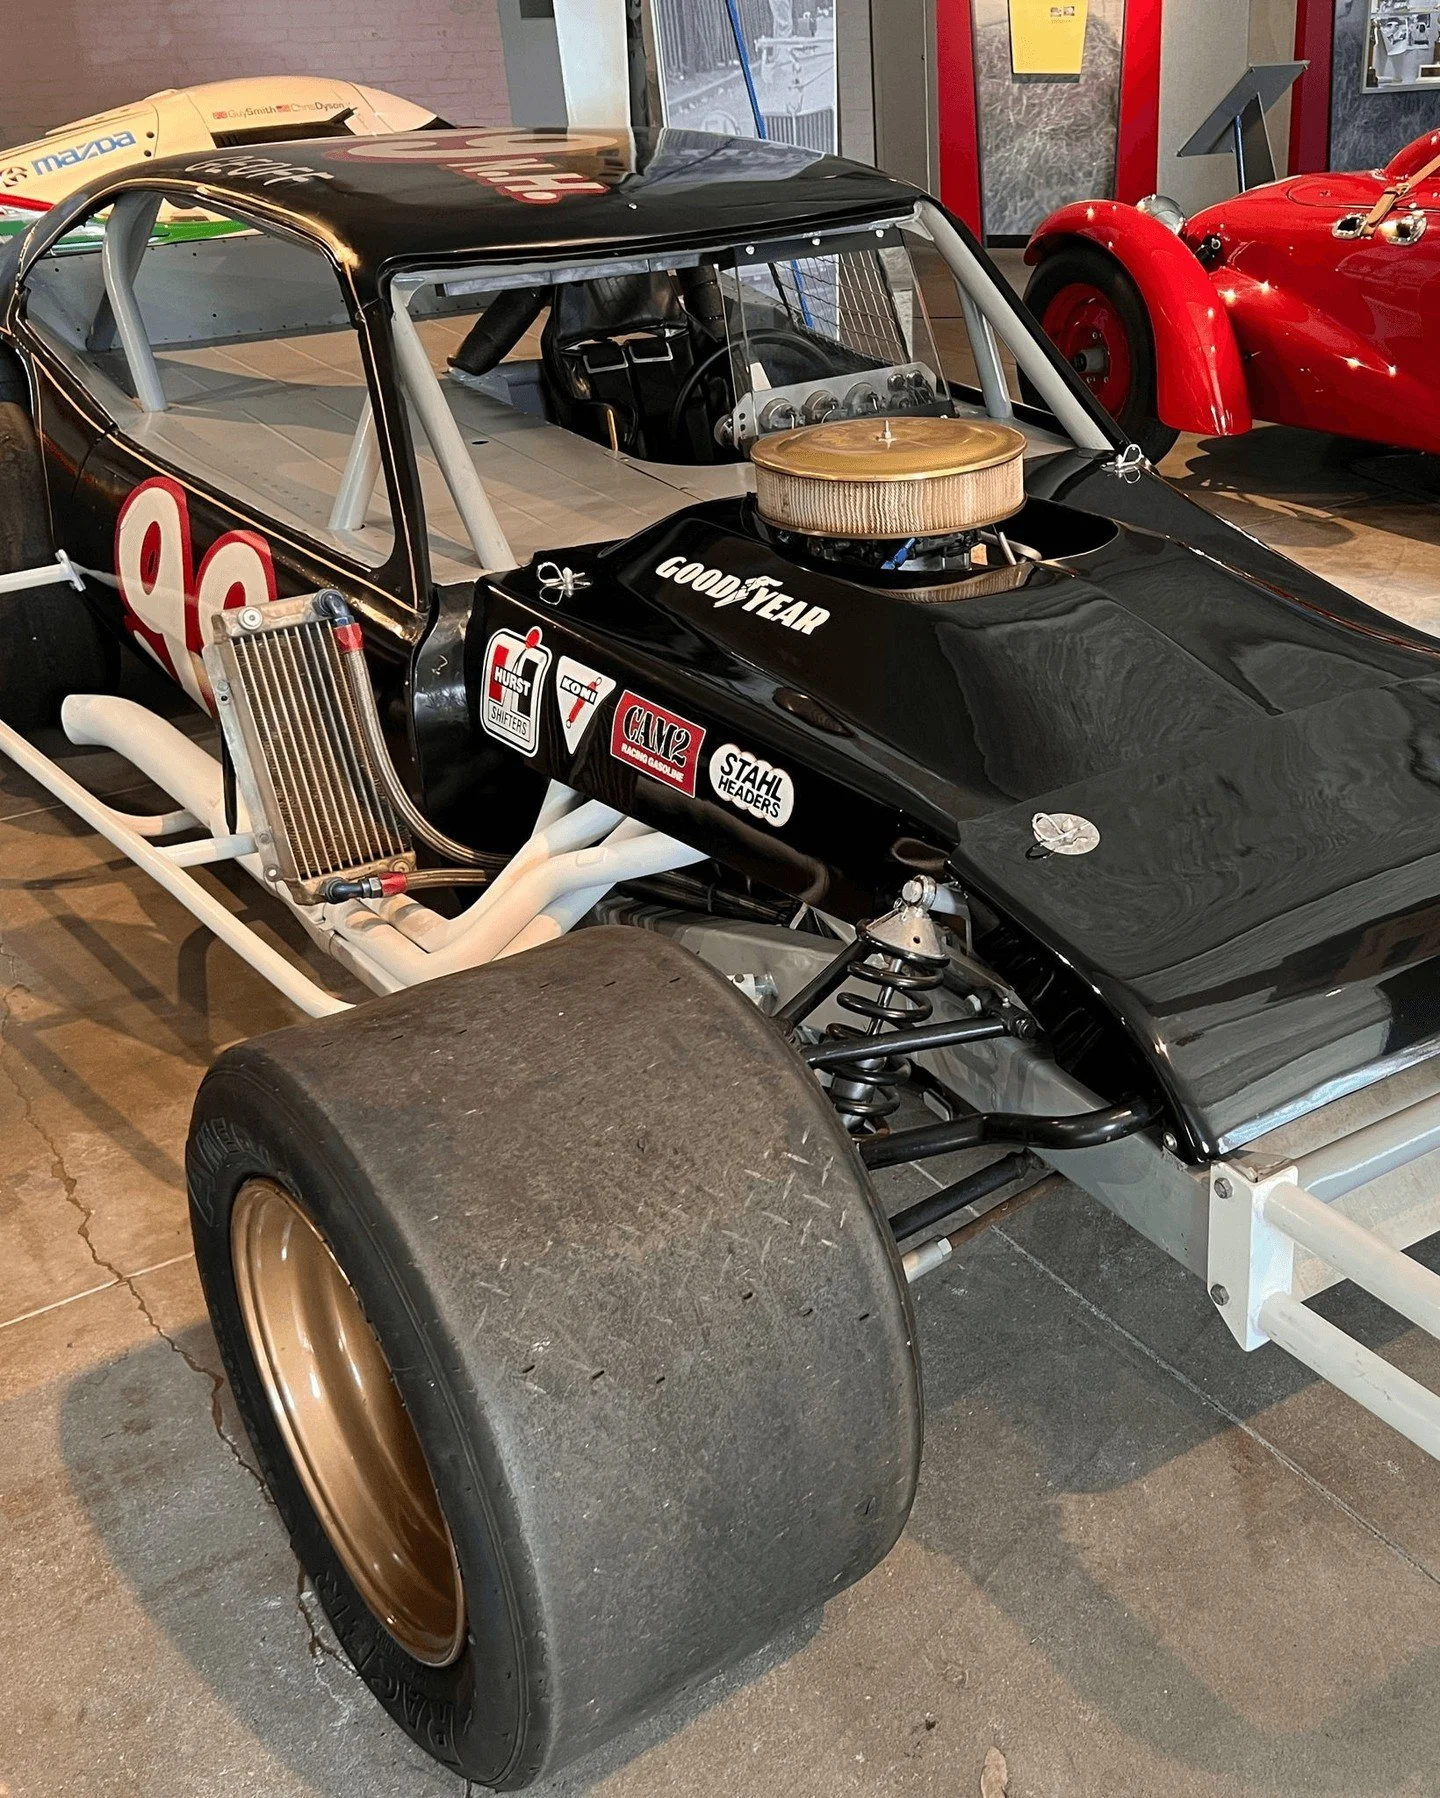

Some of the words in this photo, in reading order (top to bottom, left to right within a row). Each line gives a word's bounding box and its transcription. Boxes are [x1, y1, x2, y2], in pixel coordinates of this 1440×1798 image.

[655, 556, 831, 636] GOODYEAR
[494, 666, 532, 697] HURST
[561, 676, 597, 704] KONI
[490, 705, 528, 736] SHIFTERS
[623, 704, 692, 768] CAM2
[621, 742, 649, 765] RACING
[647, 756, 685, 783] GASOLINE
[720, 752, 783, 803] STAHL
[718, 775, 781, 819] HEADERS
